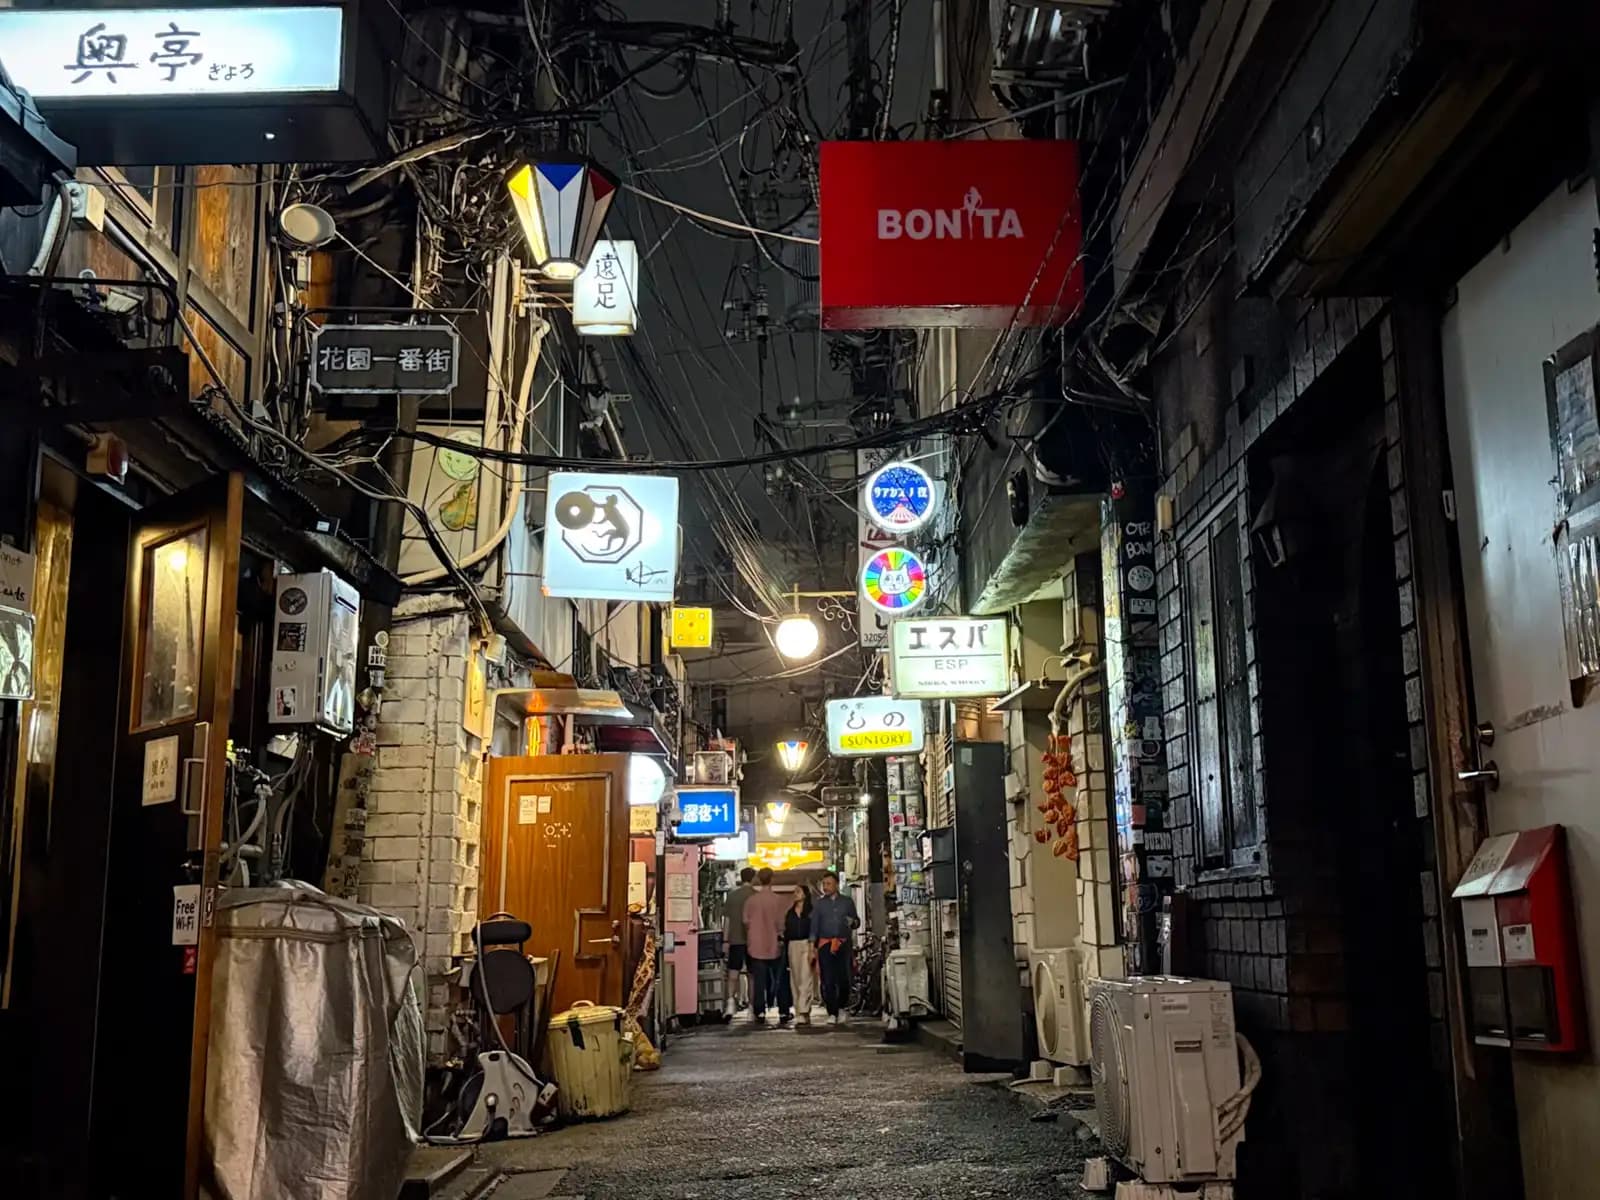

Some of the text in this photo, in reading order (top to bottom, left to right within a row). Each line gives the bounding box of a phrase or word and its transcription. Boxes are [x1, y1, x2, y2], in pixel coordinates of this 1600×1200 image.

[878, 208, 1025, 240] BONITA
[594, 252, 617, 309] 遠足
[319, 346, 451, 373] 花園一番街
[909, 624, 988, 650] エスパ
[934, 659, 969, 670] ESP
[847, 733, 905, 747] SUNTORY
[683, 803, 729, 823] 深夜+1
[176, 899, 195, 915] Free
[175, 915, 195, 931] Wi-Fi
